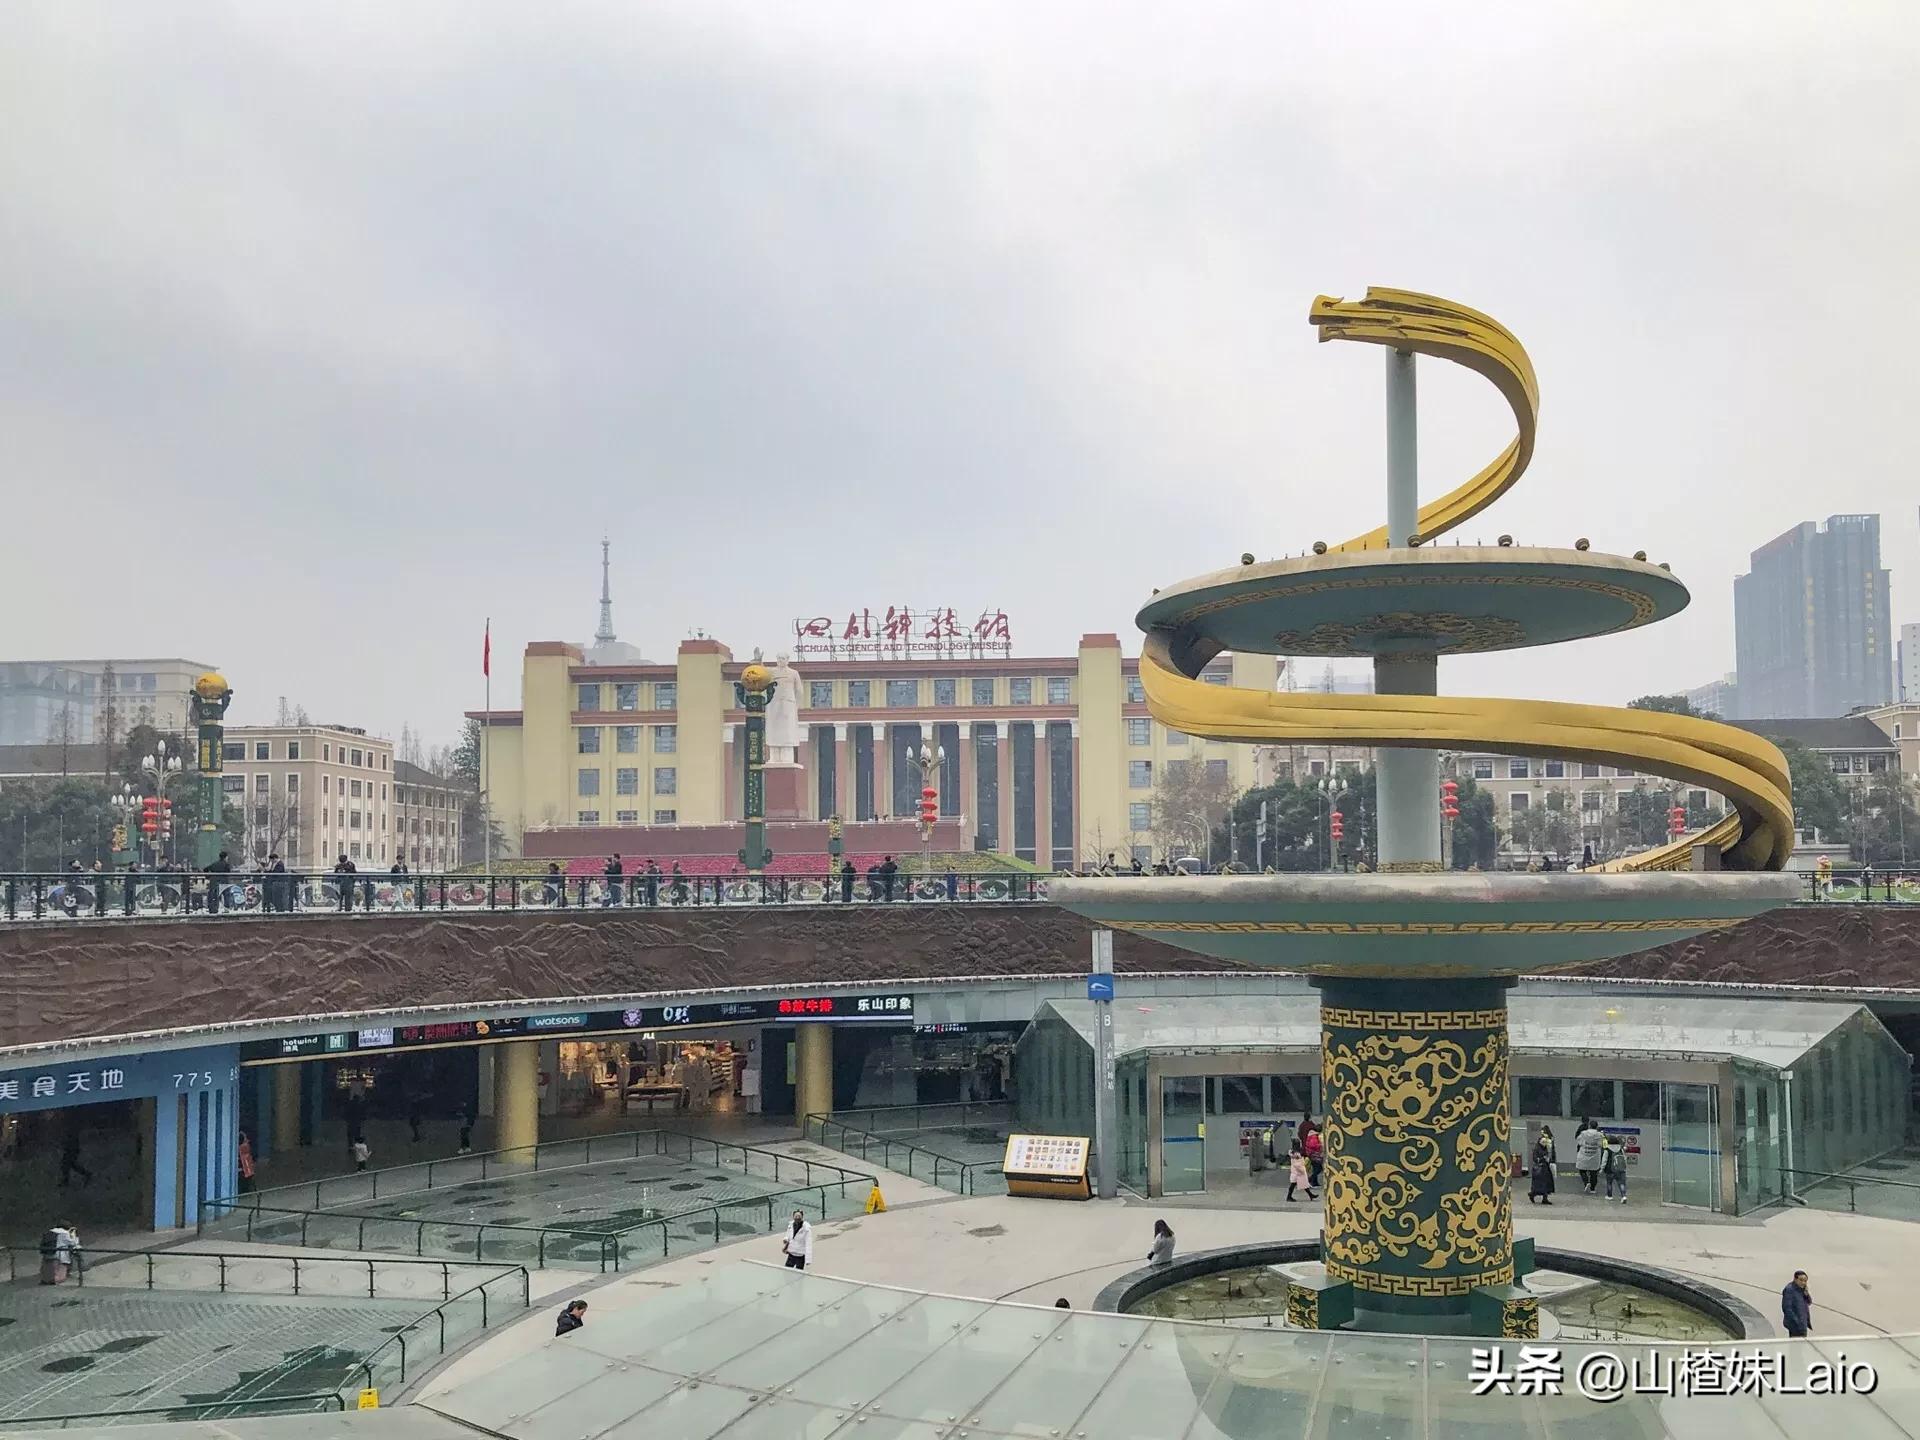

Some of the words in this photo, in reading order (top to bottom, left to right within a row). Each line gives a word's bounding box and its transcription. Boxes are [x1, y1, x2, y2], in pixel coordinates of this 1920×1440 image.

[794, 644, 835, 653] SICHUAN
[839, 643, 879, 652] SCIENCE
[884, 643, 903, 652] AND
[907, 642, 969, 651] TECHNOLOGY
[972, 641, 1012, 650] MUSEUM
[857, 997, 912, 1011] 乐山印象
[535, 1016, 580, 1026] watsons
[1104, 1014, 1111, 1026] B
[283, 1037, 318, 1046] hotwind
[0, 1069, 124, 1100] 美食天地
